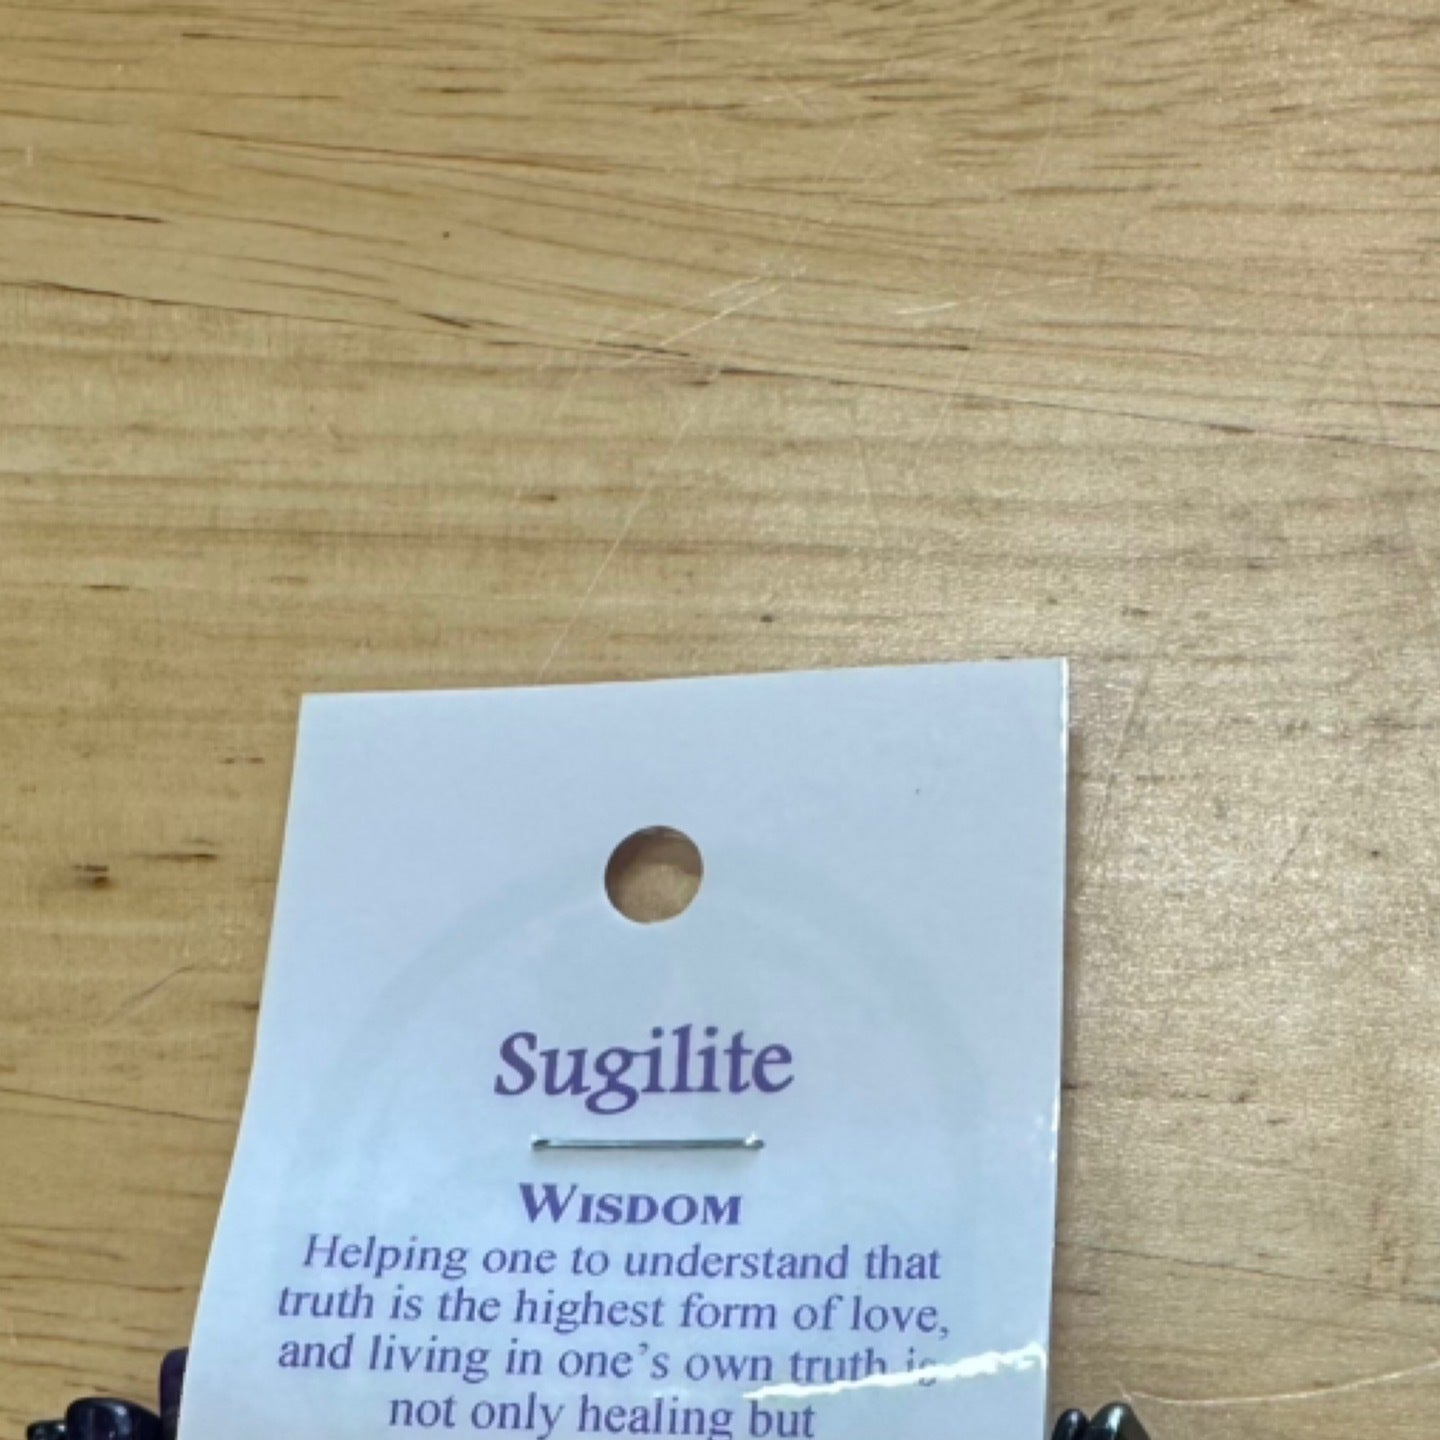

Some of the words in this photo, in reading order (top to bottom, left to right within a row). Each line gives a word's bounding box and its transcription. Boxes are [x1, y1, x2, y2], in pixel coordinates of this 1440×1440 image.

[494, 1024, 794, 1115] Sugilite
[519, 1183, 741, 1225] WISDOM
[303, 1234, 468, 1281] Helping
[483, 1249, 557, 1274] one
[571, 1247, 610, 1276] to
[625, 1243, 849, 1279] understand
[865, 1244, 940, 1279] that
[278, 1284, 373, 1318] truth
[390, 1286, 422, 1321] is
[438, 1286, 501, 1322] the
[514, 1288, 664, 1335] highest
[680, 1293, 776, 1329] form
[794, 1295, 843, 1330] of
[851, 1296, 949, 1338] love,
[278, 1333, 353, 1370] and
[369, 1334, 489, 1384] living
[506, 1341, 542, 1375] in
[559, 1342, 669, 1379] one’s
[684, 1355, 772, 1381] own
[790, 1347, 886, 1383] truth
[390, 1397, 455, 1428] not
[471, 1392, 564, 1440] only
[749, 1400, 815, 1439] but
